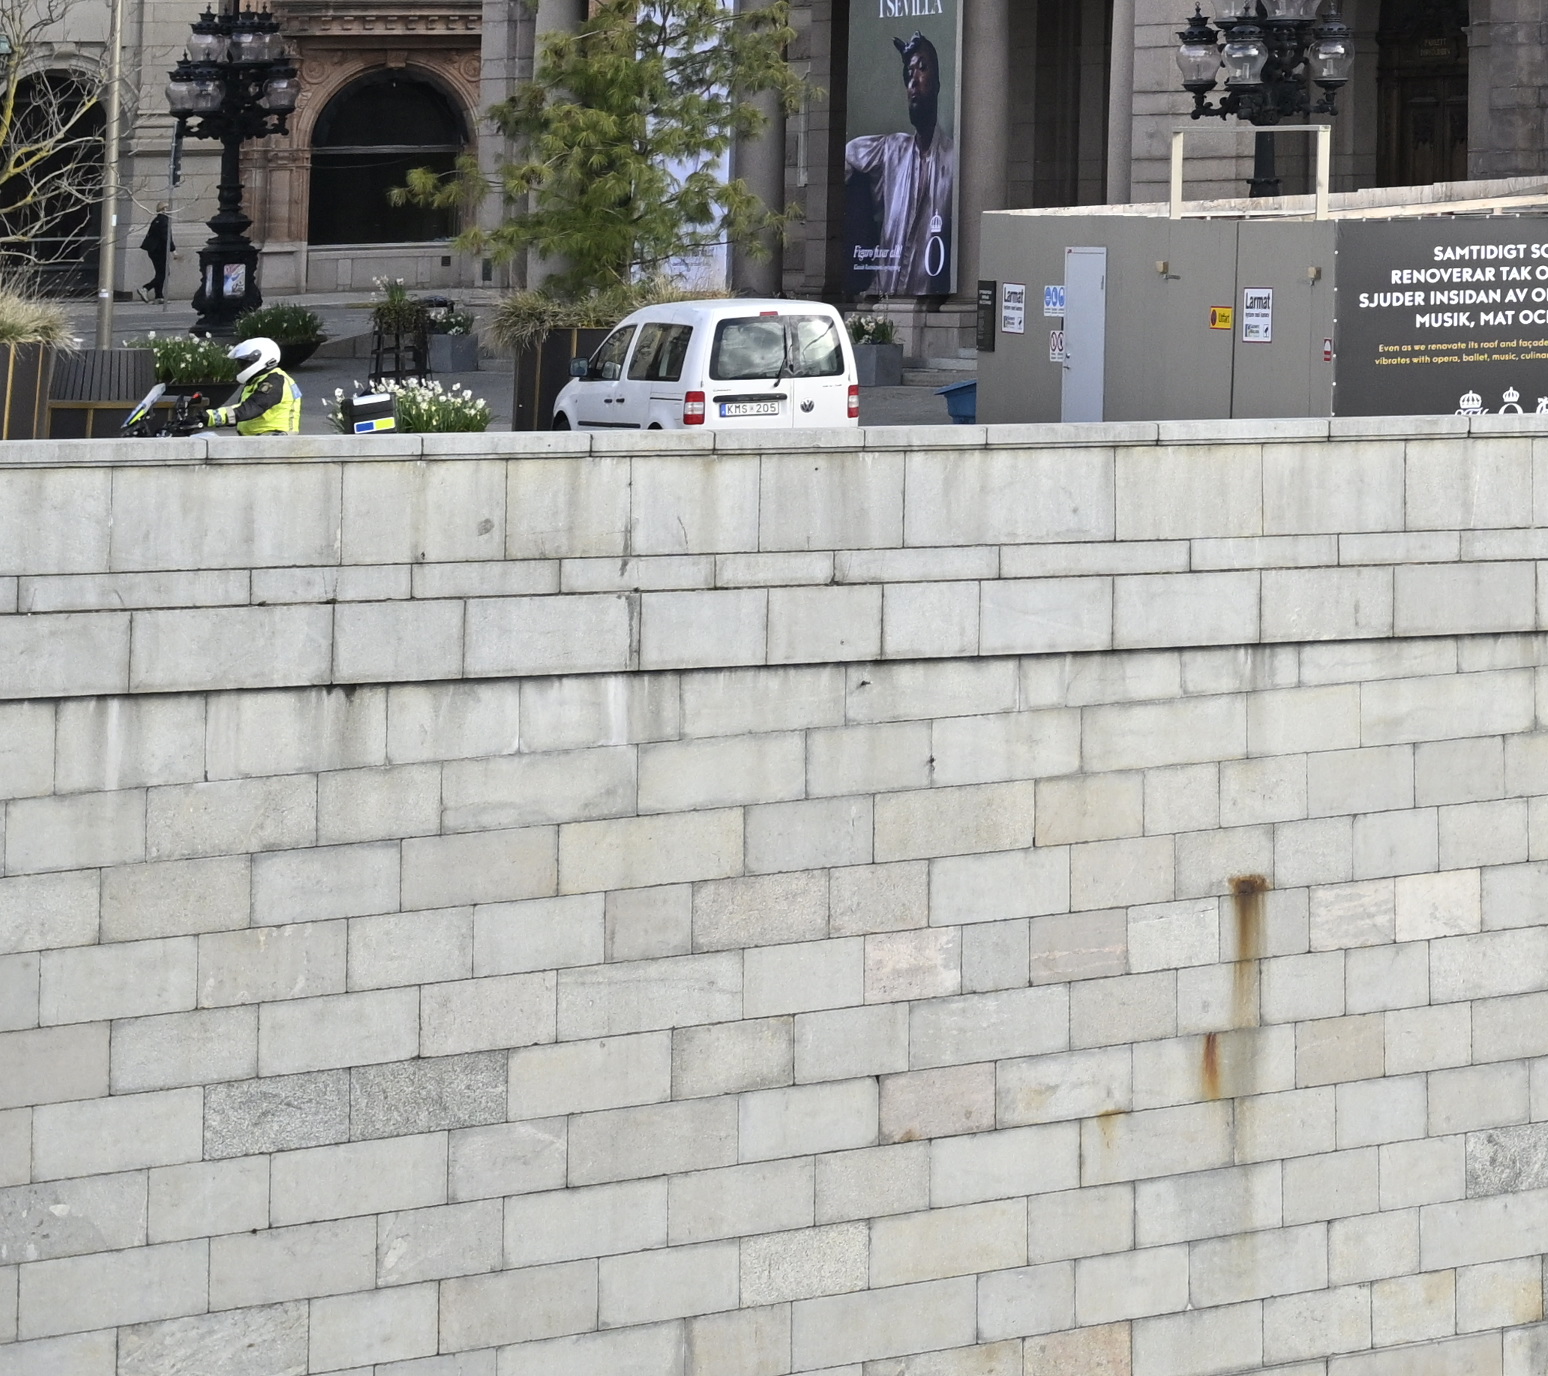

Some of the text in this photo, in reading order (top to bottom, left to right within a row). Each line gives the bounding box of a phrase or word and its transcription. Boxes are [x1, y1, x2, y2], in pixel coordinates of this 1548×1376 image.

[853, 245, 873, 261] Figaro
[1433, 244, 1526, 261] SAMTIDIGT
[1391, 266, 1495, 284] RENOVERAR
[1500, 266, 1532, 281] TAK
[1004, 287, 1024, 304] Larmat
[1246, 292, 1270, 310] Larmat
[1359, 291, 1425, 308] SJUDER
[1430, 289, 1501, 306] INSIDAN
[1505, 287, 1529, 303] AV
[1415, 312, 1476, 328] MUSIK,
[1480, 311, 1515, 326] MAT
[1379, 344, 1400, 352] Even
[1427, 342, 1466, 350] renovate
[1468, 341, 1478, 349] its
[1480, 341, 1498, 349] roof
[1500, 340, 1517, 348] and
[1375, 356, 1410, 365] vibrates
[1412, 355, 1430, 363] with
[1432, 355, 1460, 364] opera,
[1462, 353, 1490, 362] ballet,
[1492, 352, 1518, 361] music,
[727, 403, 776, 414] KMS 205
